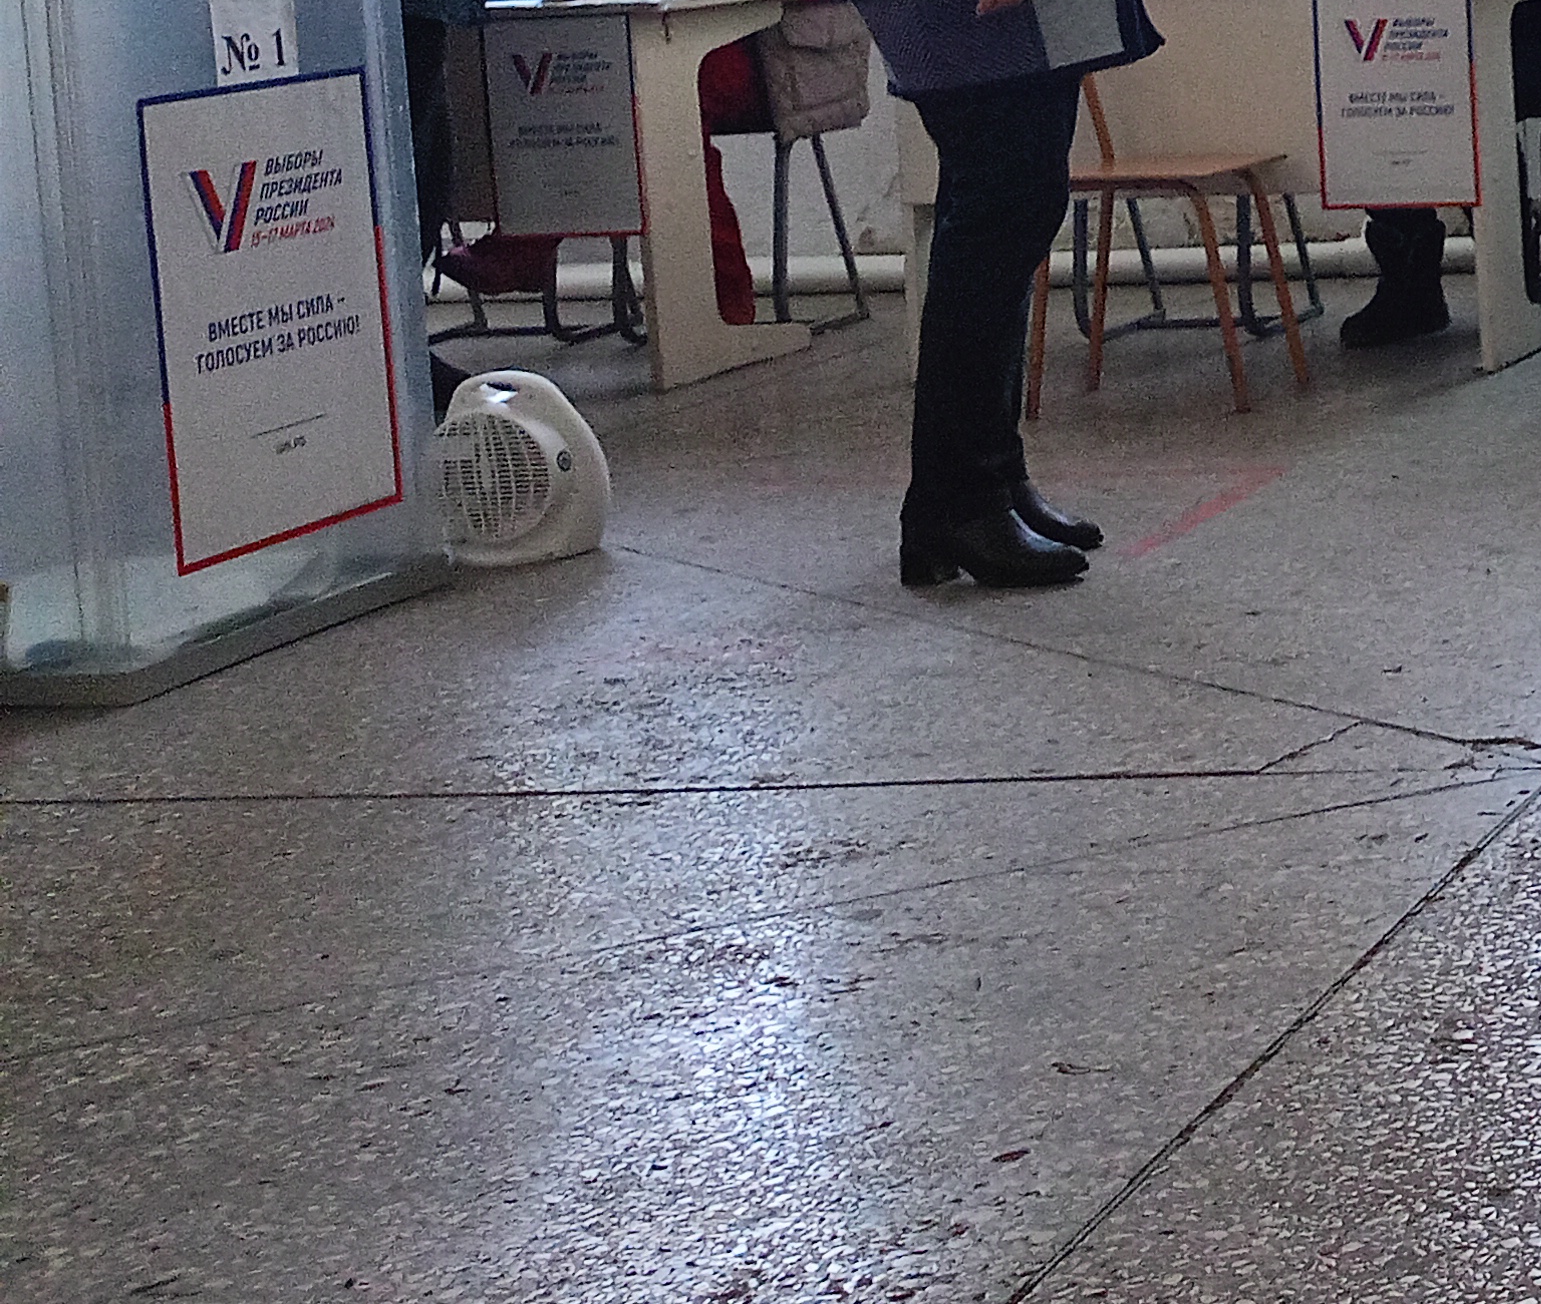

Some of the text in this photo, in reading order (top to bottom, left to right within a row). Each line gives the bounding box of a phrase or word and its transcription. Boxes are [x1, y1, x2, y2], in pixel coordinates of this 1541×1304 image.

[220, 28, 286, 76] № 1
[264, 148, 324, 177] ВЫБОРЫ
[259, 168, 343, 201] ПРЕЗИДЕНТА
[253, 198, 310, 227] РОССИИ
[207, 309, 265, 343] ВМЕСТЕ
[268, 302, 294, 325] МЫ
[296, 293, 334, 319] СИЛА
[194, 314, 361, 375] ГОЛОСУЕМ ЗА РОССИЮ!
